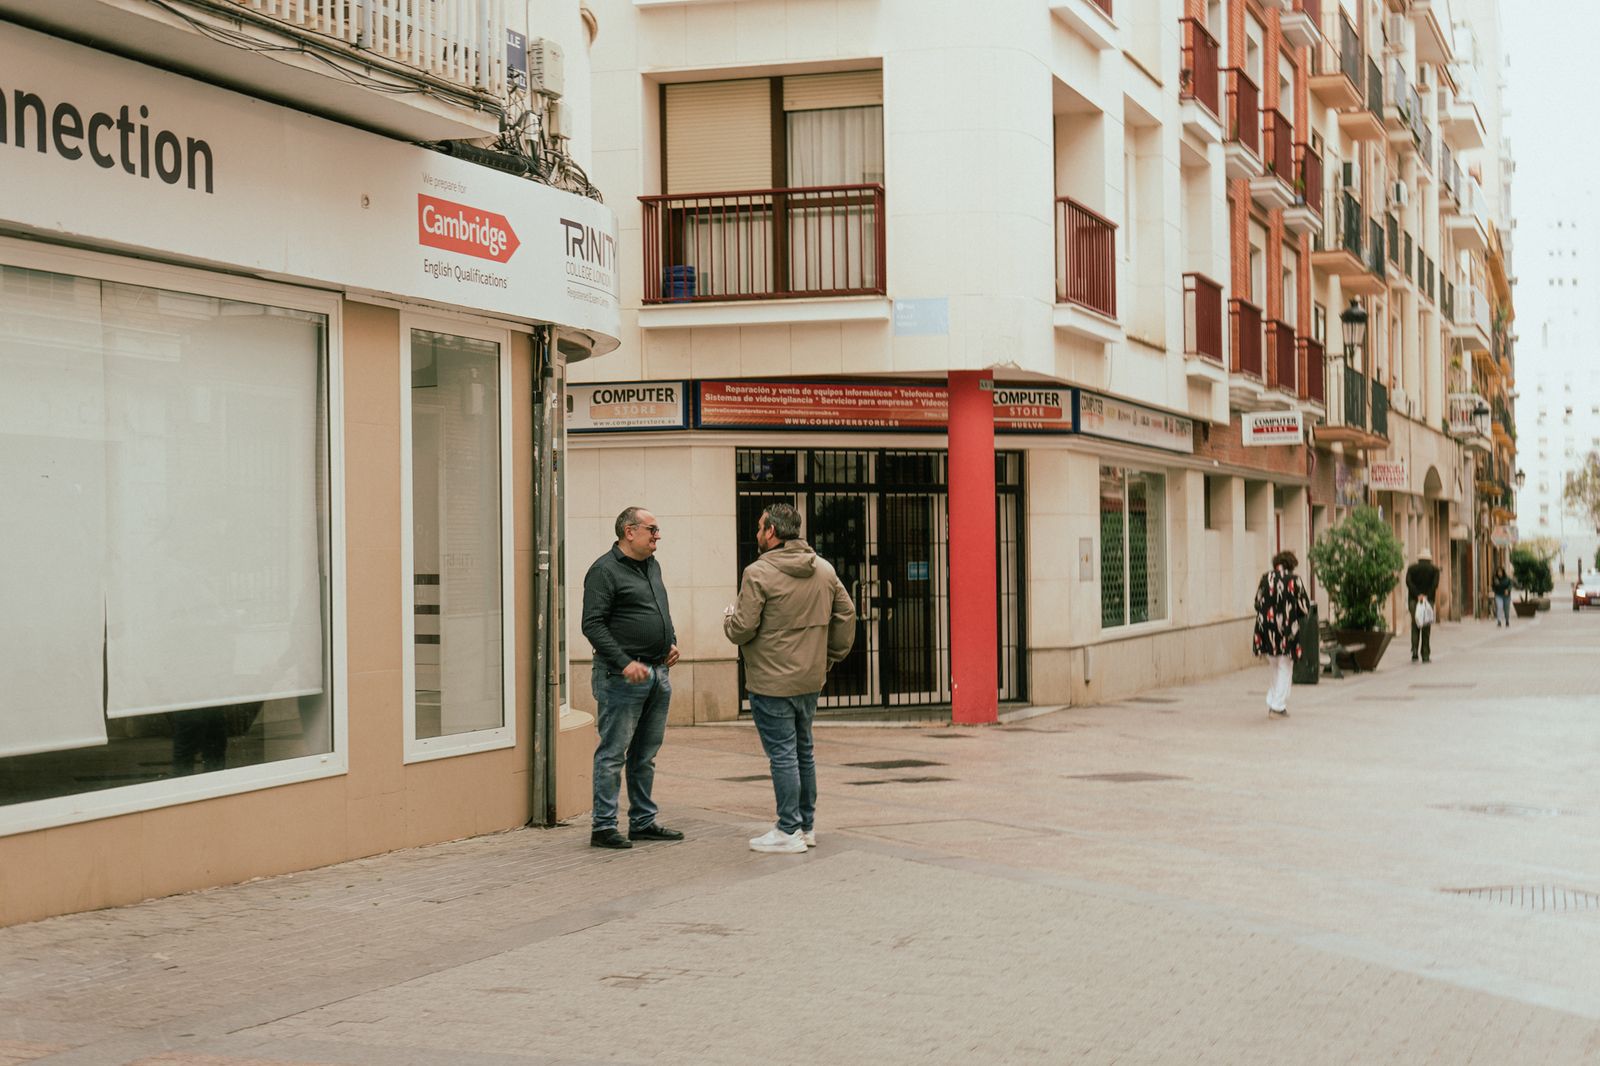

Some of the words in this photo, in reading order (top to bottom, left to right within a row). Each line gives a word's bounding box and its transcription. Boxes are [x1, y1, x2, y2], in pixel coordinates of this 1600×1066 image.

[0, 87, 213, 194] nection
[423, 172, 433, 185] We
[434, 177, 457, 192] prepare
[422, 204, 507, 256] Cambridge
[560, 217, 616, 273] TRINITY
[424, 258, 452, 279] English
[454, 265, 507, 289] Qualifications
[566, 261, 592, 281] COLLEGE
[592, 388, 675, 404] COMPUTER
[725, 384, 770, 395] Reparación
[772, 387, 777, 395] y
[779, 386, 800, 394] venta
[802, 386, 811, 395] de
[813, 387, 843, 397] equipos
[704, 393, 741, 402] Sistemas
[743, 394, 753, 402] de
[755, 395, 813, 405] videovigilancia
[821, 396, 857, 405] Servicios
[858, 398, 875, 408] para
[877, 399, 913, 409] empresas
[993, 391, 1059, 406] COMPUTER
[613, 405, 657, 416] STORE
[1009, 407, 1045, 417] STORE
[593, 419, 676, 427] www.computerstore.es
[784, 418, 899, 427] WWW.COMPUTERSTORE.ES
[1011, 421, 1043, 429] HUELVA
[1254, 416, 1297, 427] COMPUTER
